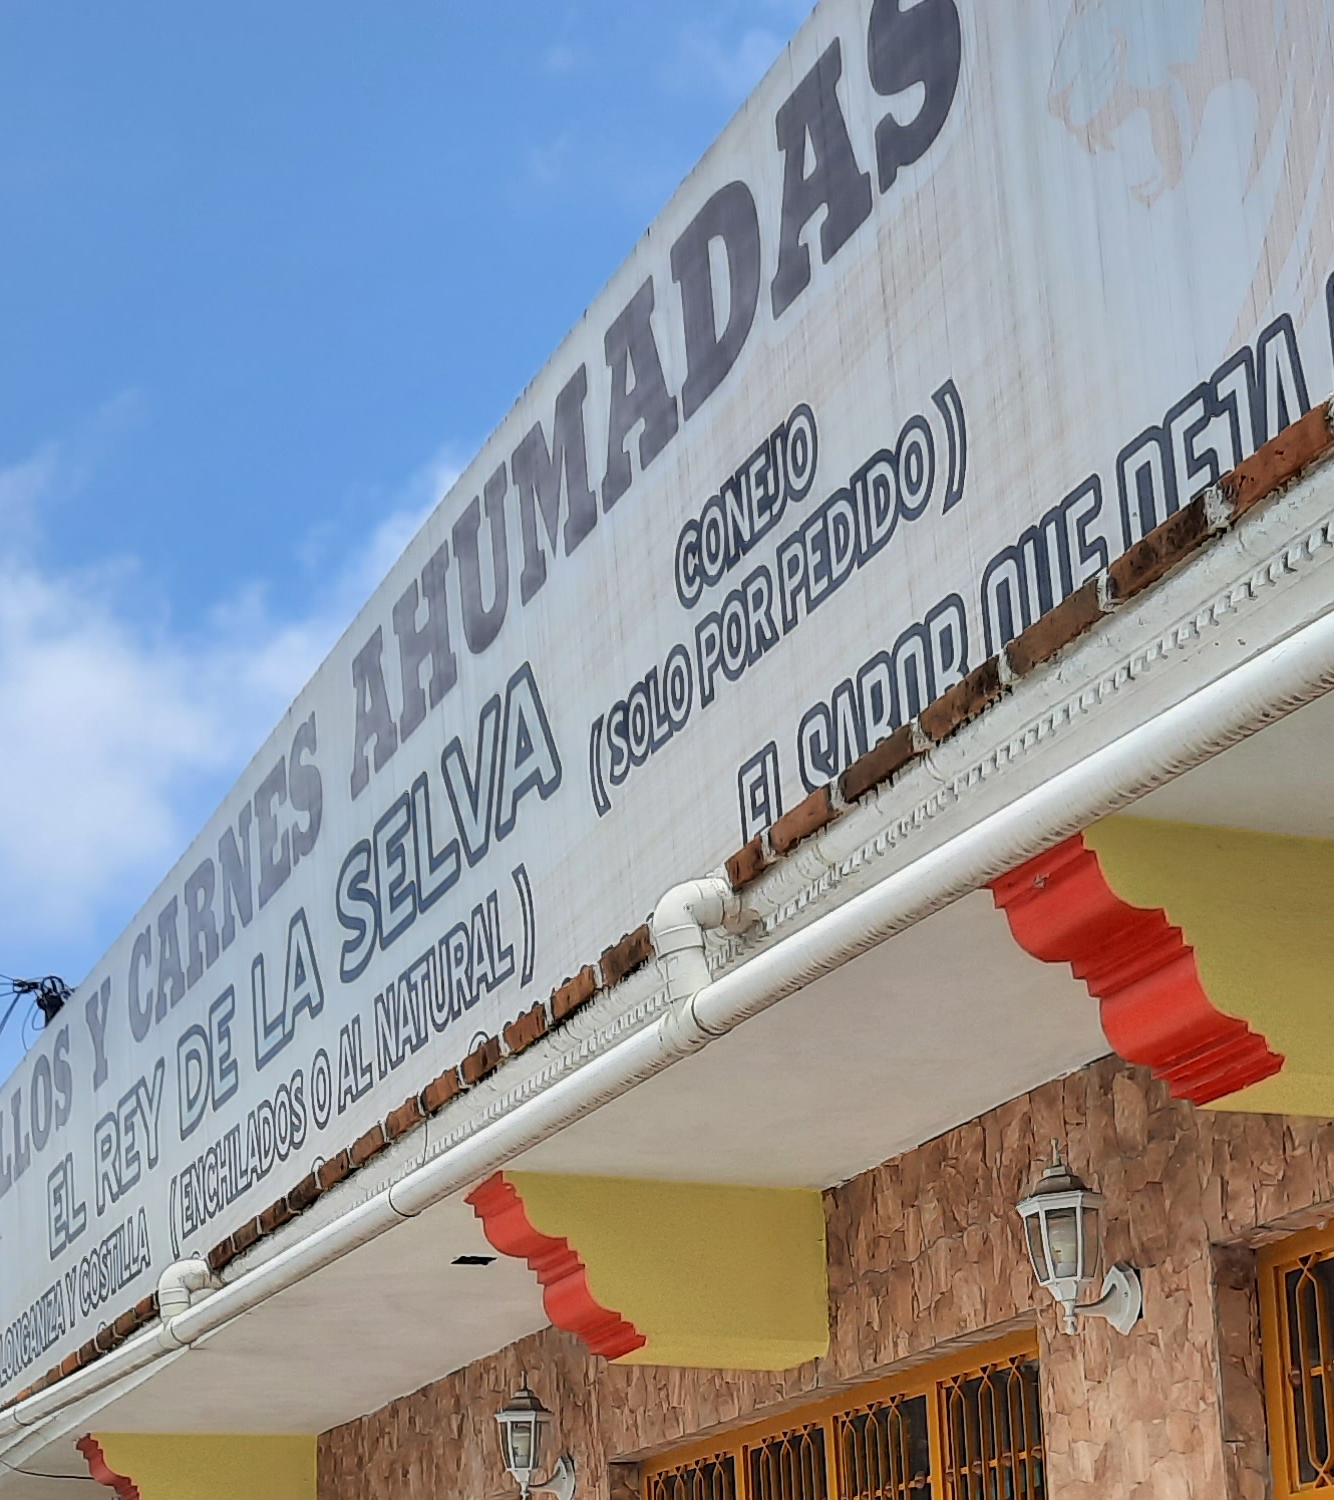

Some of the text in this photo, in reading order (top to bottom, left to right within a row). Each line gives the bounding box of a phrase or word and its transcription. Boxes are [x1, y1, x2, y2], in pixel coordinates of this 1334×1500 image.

[85, 975, 111, 1092] Y
[128, 711, 323, 1043] CARNES
[350, 0, 962, 800] AHUMADAS
[674, 402, 818, 609] CONEJO
[695, 564, 779, 710] POR
[47, 1152, 86, 1260] EL
[94, 1056, 165, 1217] REY
[177, 983, 238, 1141] DE
[251, 906, 324, 1072] LA
[335, 661, 562, 983] SELVA
[65, 1265, 78, 1328] Y
[78, 1206, 151, 1317] COSTILLA
[310, 1047, 333, 1131] O
[338, 1013, 373, 1115] AL
